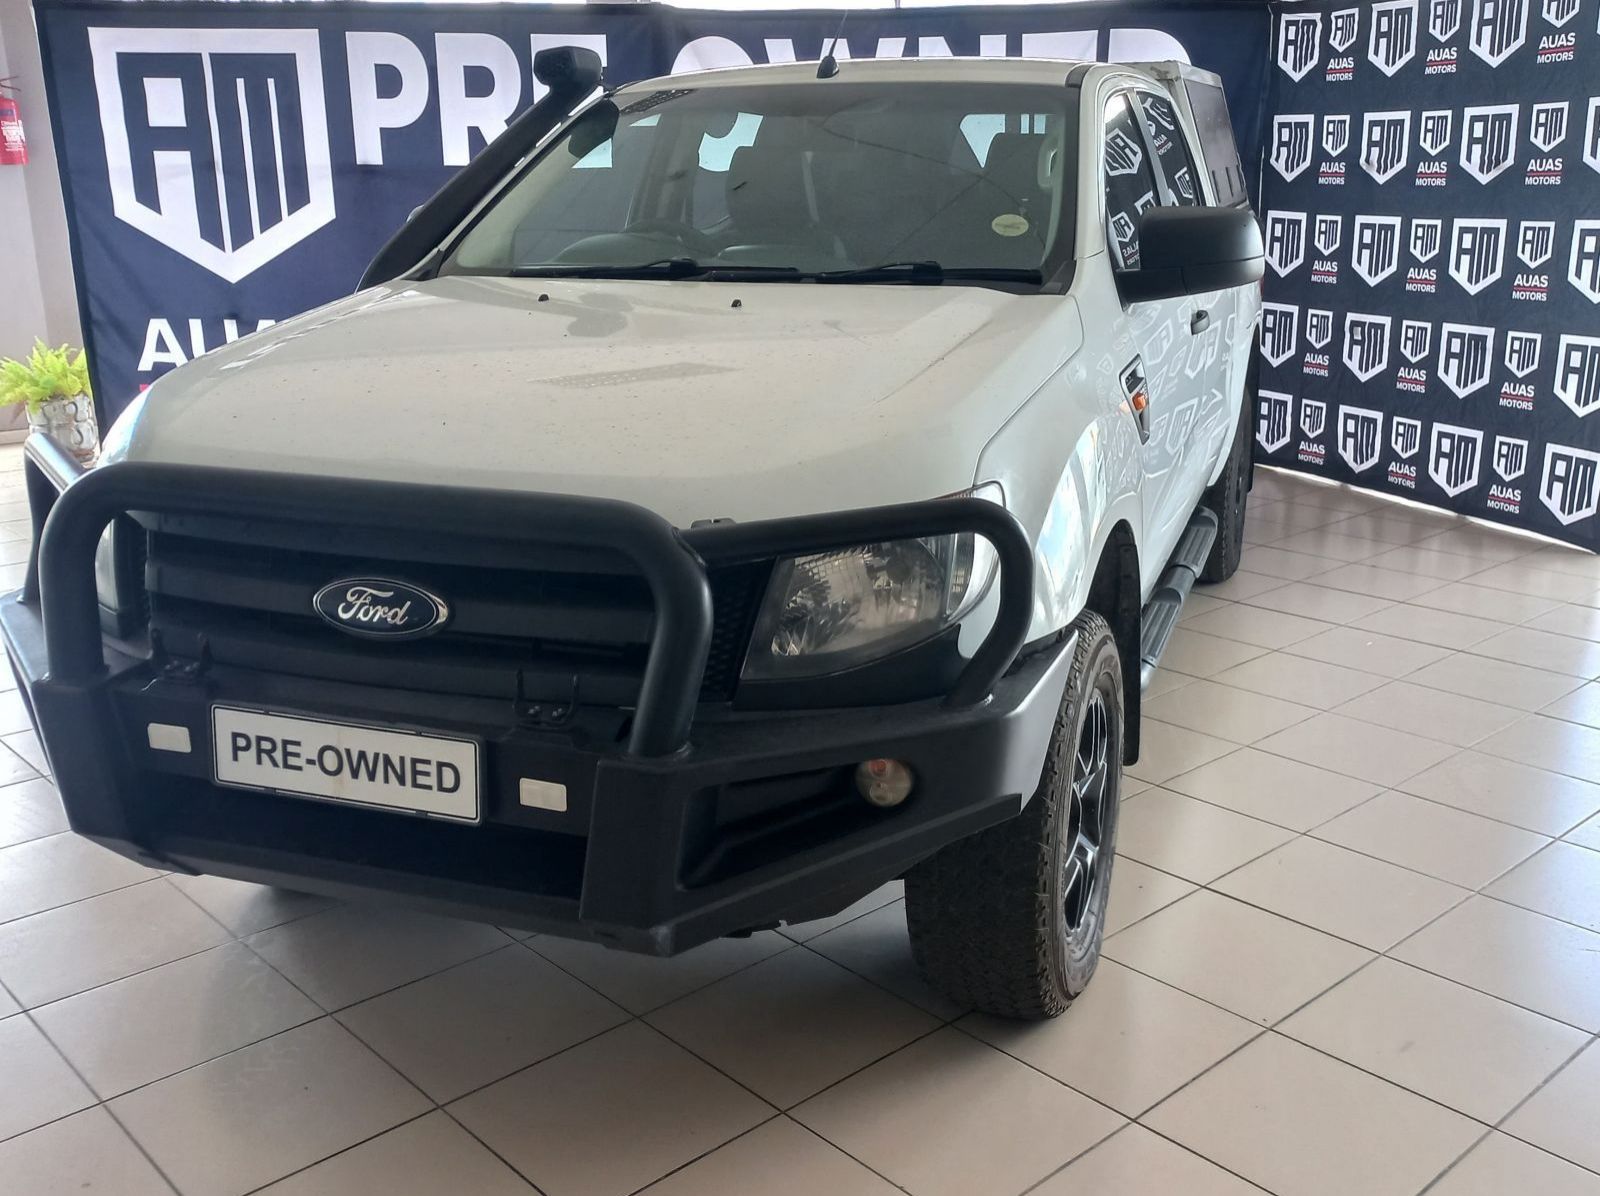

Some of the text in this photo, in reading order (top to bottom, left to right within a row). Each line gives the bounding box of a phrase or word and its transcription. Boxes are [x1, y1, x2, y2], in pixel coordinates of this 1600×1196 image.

[1538, 32, 1577, 50] AUAS
[1426, 47, 1458, 62] AUAS
[1536, 51, 1574, 65] MOTORS
[1326, 56, 1355, 70] AUAS
[1424, 64, 1457, 75] MOTORS
[1325, 72, 1354, 83] MOTORS
[1319, 161, 1346, 174] AUAS
[1416, 161, 1448, 174] AUAS
[1526, 158, 1563, 172] AUAS
[1318, 176, 1345, 185] MOTORS
[1415, 176, 1447, 187] MOTORS
[1524, 175, 1561, 185] MOTORS
[1312, 260, 1338, 273] AUAS
[1310, 273, 1337, 285] MOTORS
[1406, 268, 1437, 281] AUAS
[1513, 273, 1549, 288] AUAS
[1405, 282, 1436, 293] MOTORS
[1511, 290, 1548, 302] MOTORS
[1304, 353, 1330, 366] AUAS
[1302, 365, 1329, 377] MOTORS
[1397, 366, 1427, 381] AUAS
[1396, 381, 1426, 394] MOTORS
[1500, 381, 1535, 398] AUAS
[1498, 397, 1534, 411] MOTORS
[1298, 442, 1326, 456] AUAS
[1388, 461, 1417, 477] AUAS
[1488, 484, 1522, 502] AUAS
[1486, 499, 1520, 514] MOTORS
[338, 586, 411, 625] Ford
[230, 731, 461, 794] PRE-OWNED
